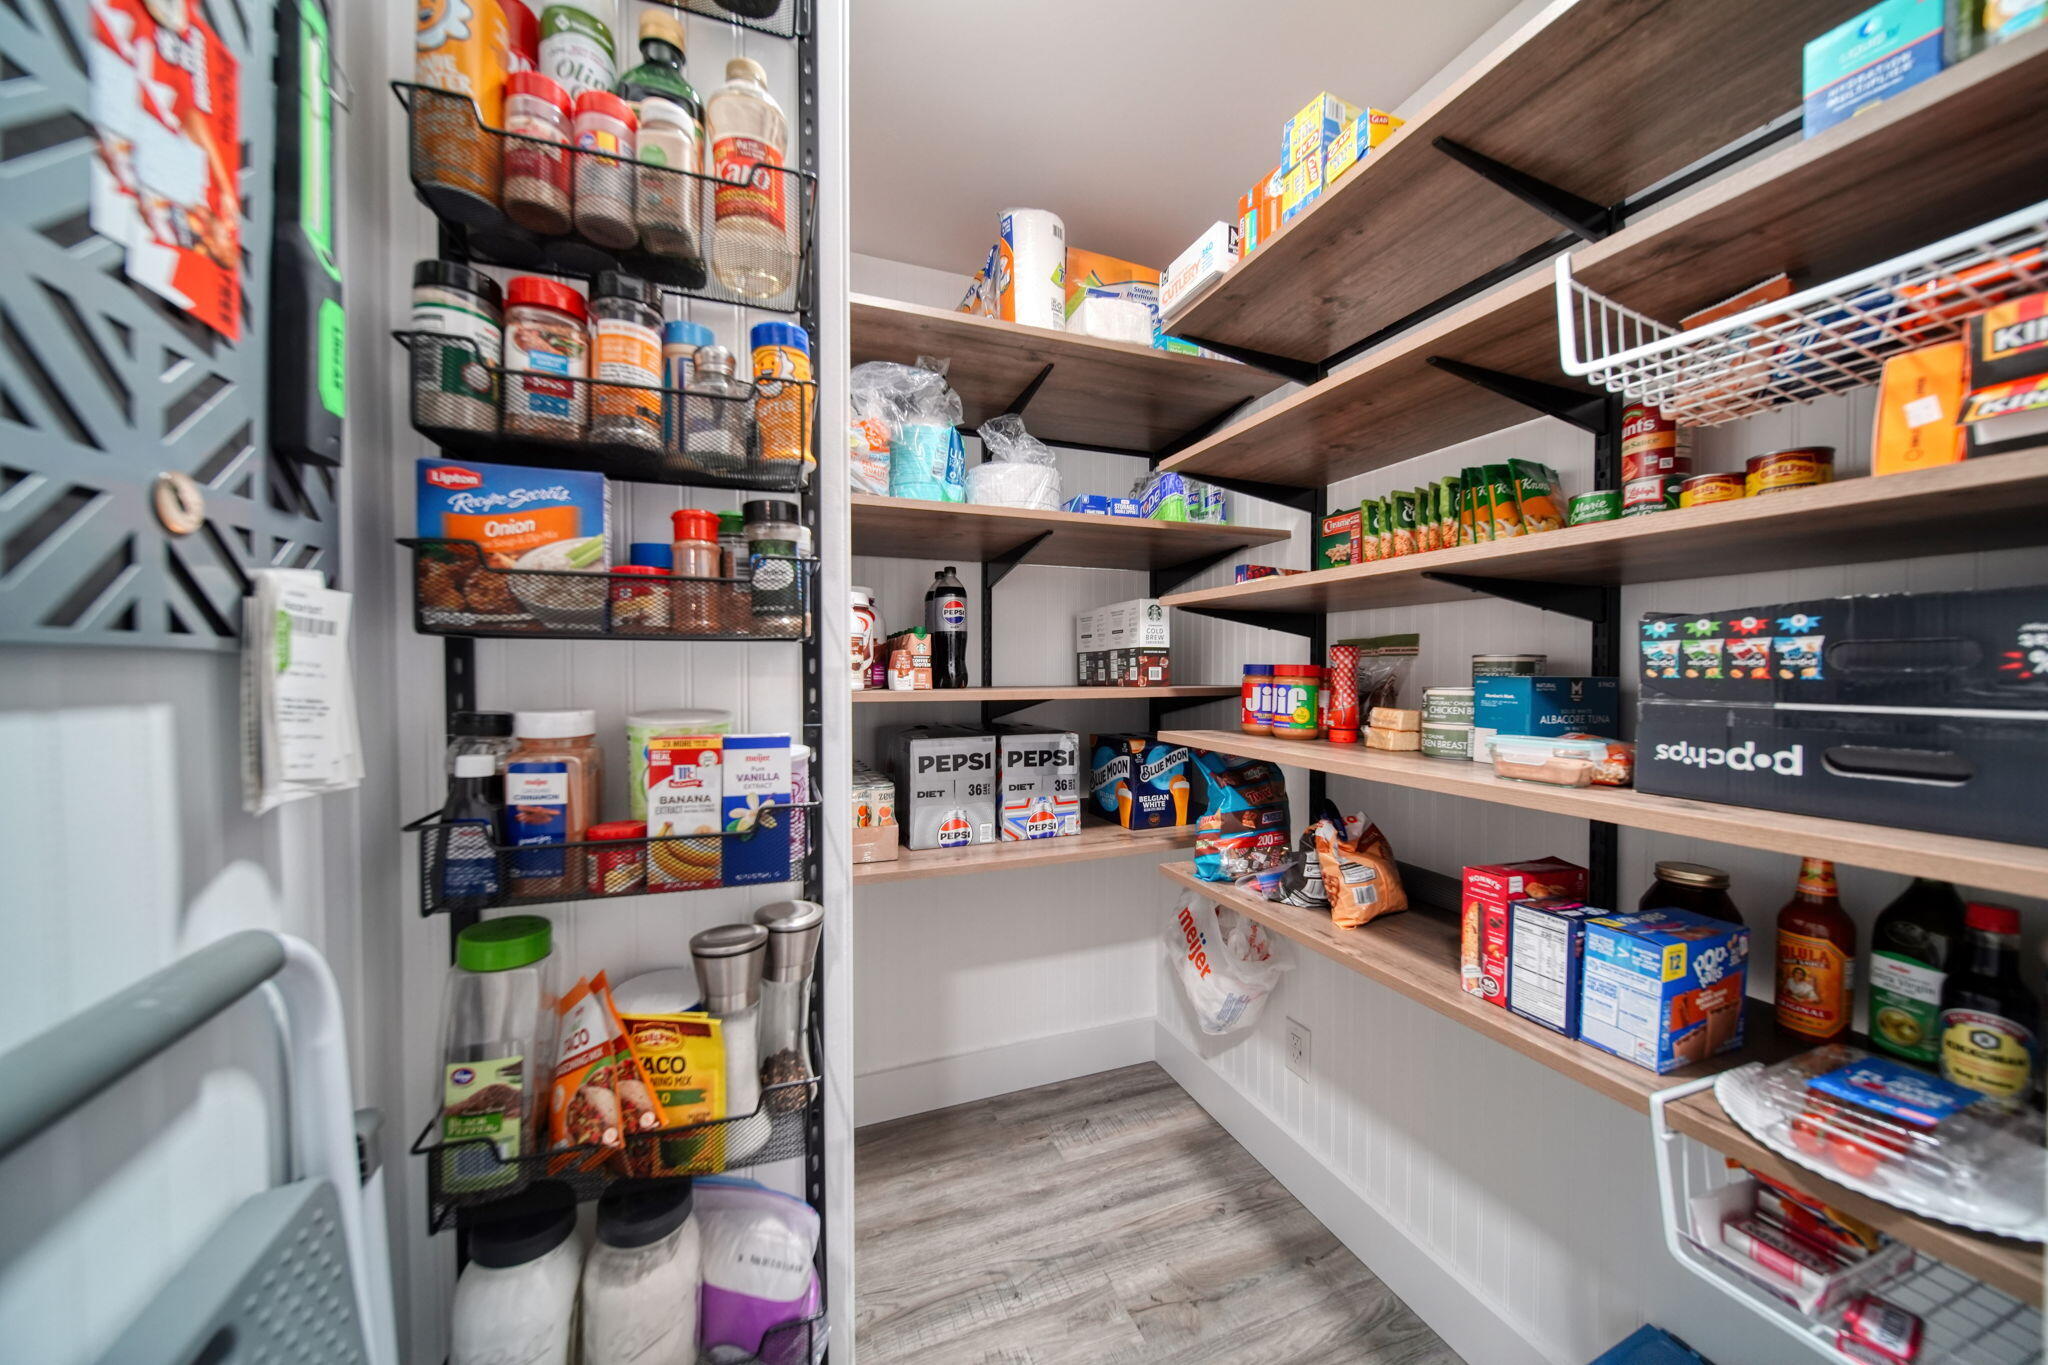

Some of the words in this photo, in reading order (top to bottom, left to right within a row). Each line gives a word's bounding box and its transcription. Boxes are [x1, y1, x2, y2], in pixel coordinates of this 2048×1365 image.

[1162, 259, 1201, 304] CUTLERY
[1133, 286, 1153, 295] Super
[1127, 291, 1159, 302] Premium
[431, 470, 479, 485] Lipton
[447, 492, 507, 514] Recipe
[507, 485, 572, 509] Secrets
[1575, 500, 1608, 513] Marie
[484, 519, 536, 537] Onion
[1245, 686, 1272, 711] Ji
[1429, 706, 1465, 715] CHICKEN
[1540, 715, 1585, 724] ALBACORE
[1588, 715, 1610, 723] TUNA
[1437, 740, 1468, 749] BREAST
[745, 754, 771, 763] meijer
[918, 752, 992, 774] PEPSI
[1007, 750, 1075, 768] PEPSI
[1141, 764, 1165, 781] BLUE
[1165, 749, 1188, 769] MOON
[736, 773, 780, 782] VANILLA
[1090, 769, 1107, 790] BLUE
[1106, 759, 1128, 781] MOON
[968, 784, 983, 796] 36
[1008, 783, 1035, 791] DIET
[1054, 779, 1067, 791] 36
[659, 795, 712, 804] BANANA
[916, 790, 945, 798] DIET
[1139, 794, 1170, 802] BELGIAN
[1029, 822, 1057, 832] PEPSI
[940, 831, 971, 840] PEPSI
[1257, 835, 1274, 846] 200
[1178, 906, 1212, 979] meijer
[1669, 954, 1681, 971] 12
[640, 1055, 687, 1075] ACO
[674, 1075, 692, 1086] MIX
